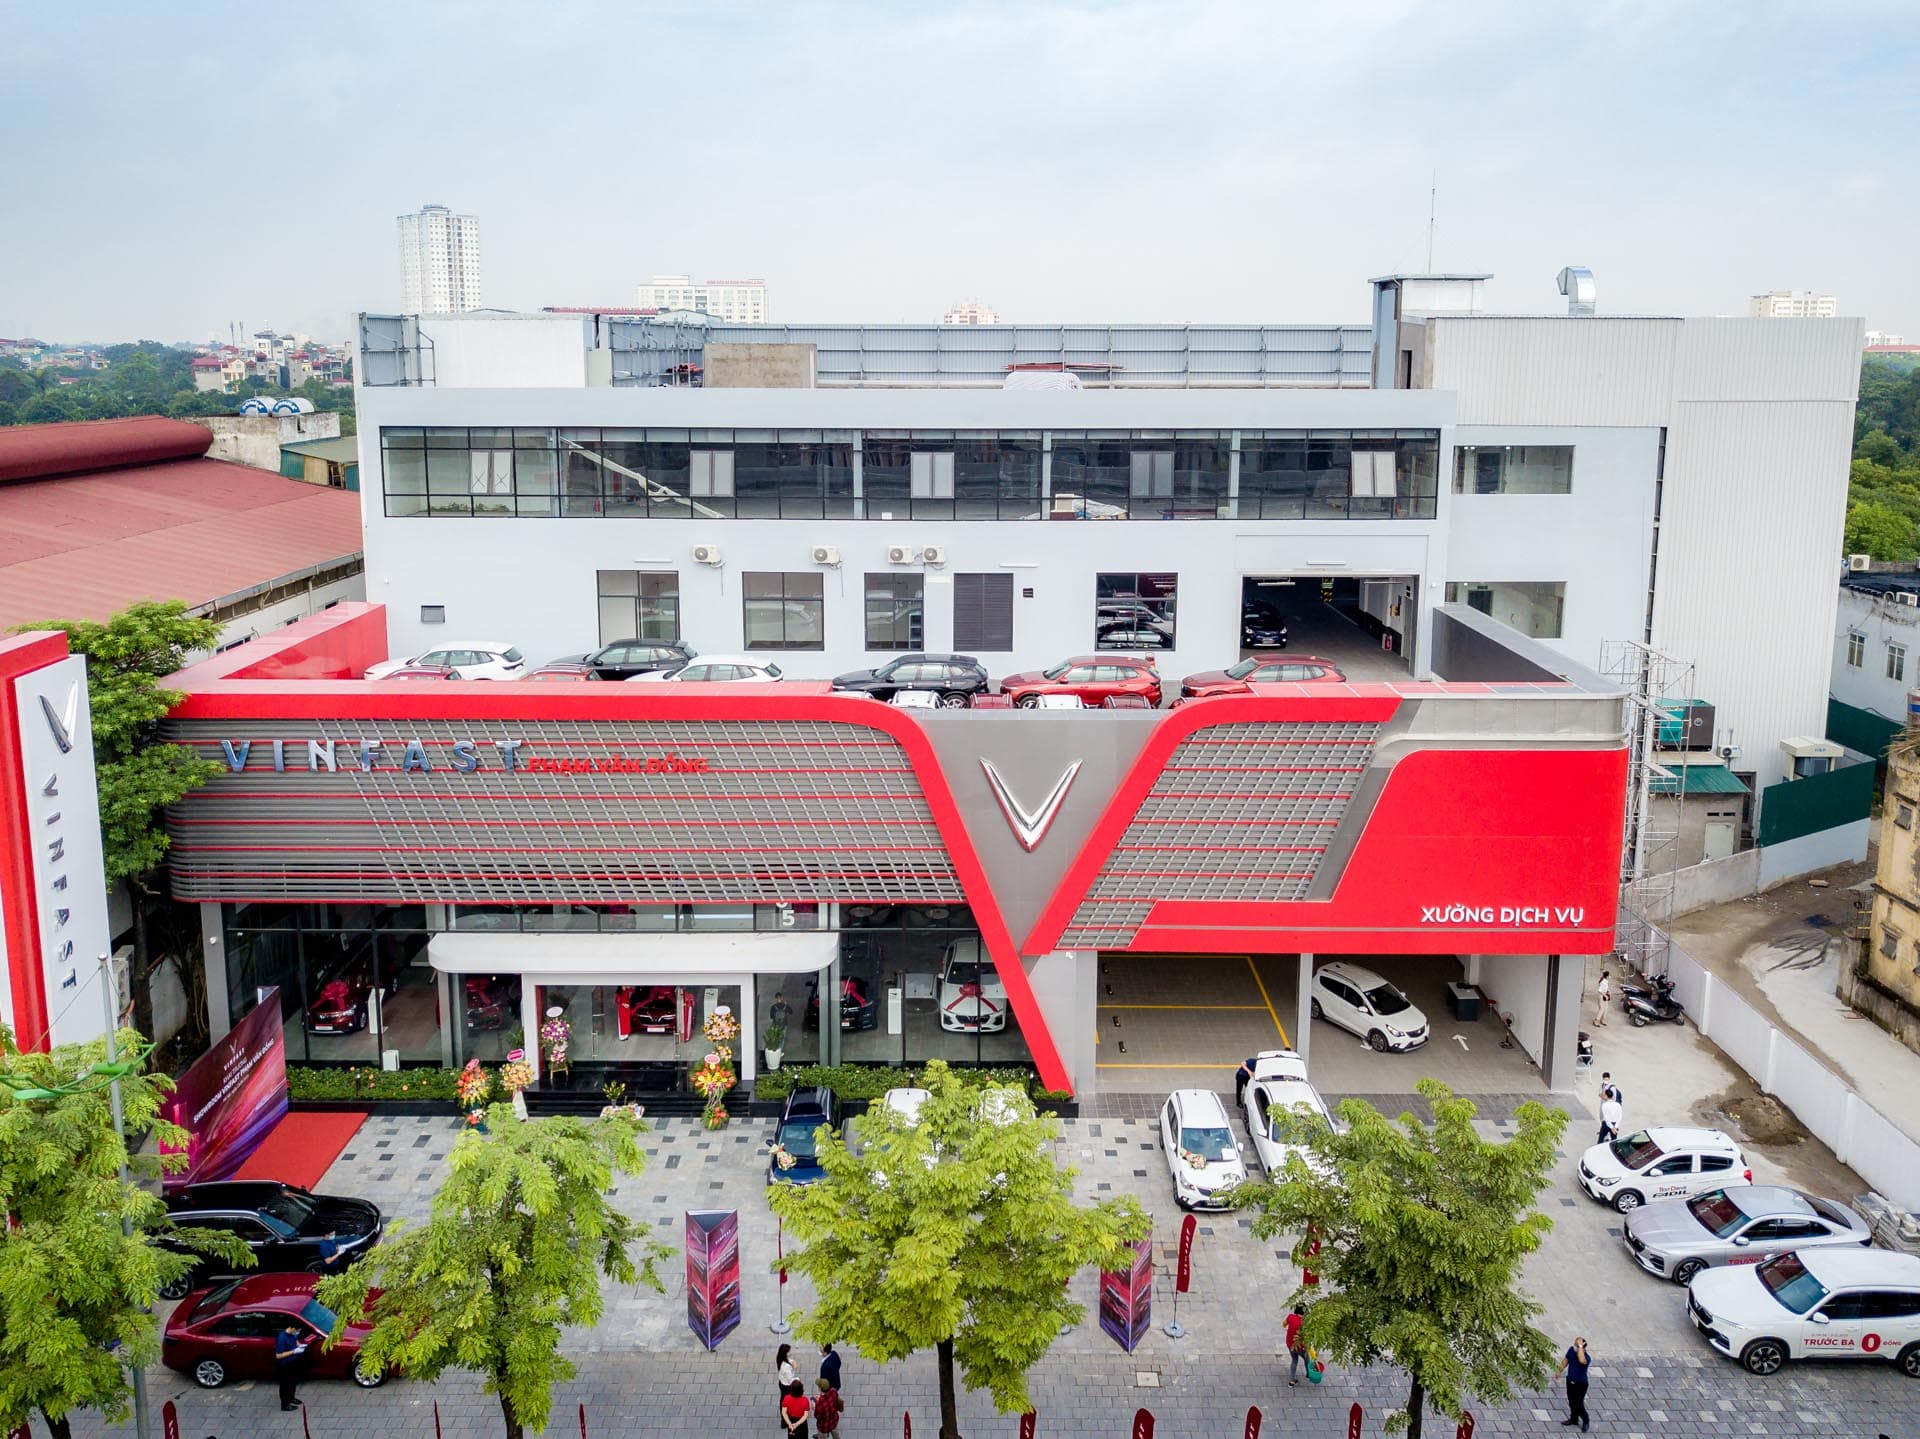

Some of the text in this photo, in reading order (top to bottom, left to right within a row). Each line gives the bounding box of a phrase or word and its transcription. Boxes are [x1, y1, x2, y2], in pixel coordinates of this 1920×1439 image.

[220, 739, 523, 773] VINFAST
[528, 757, 590, 777] PHẠM
[595, 754, 640, 773] VĂN
[41, 773, 77, 991] VINFAST
[1421, 902, 1584, 927] XƯỞNG DỊCH VỤ
[1803, 1336, 1838, 1346] TRƯỚC
[1861, 1332, 1881, 1353] 0
